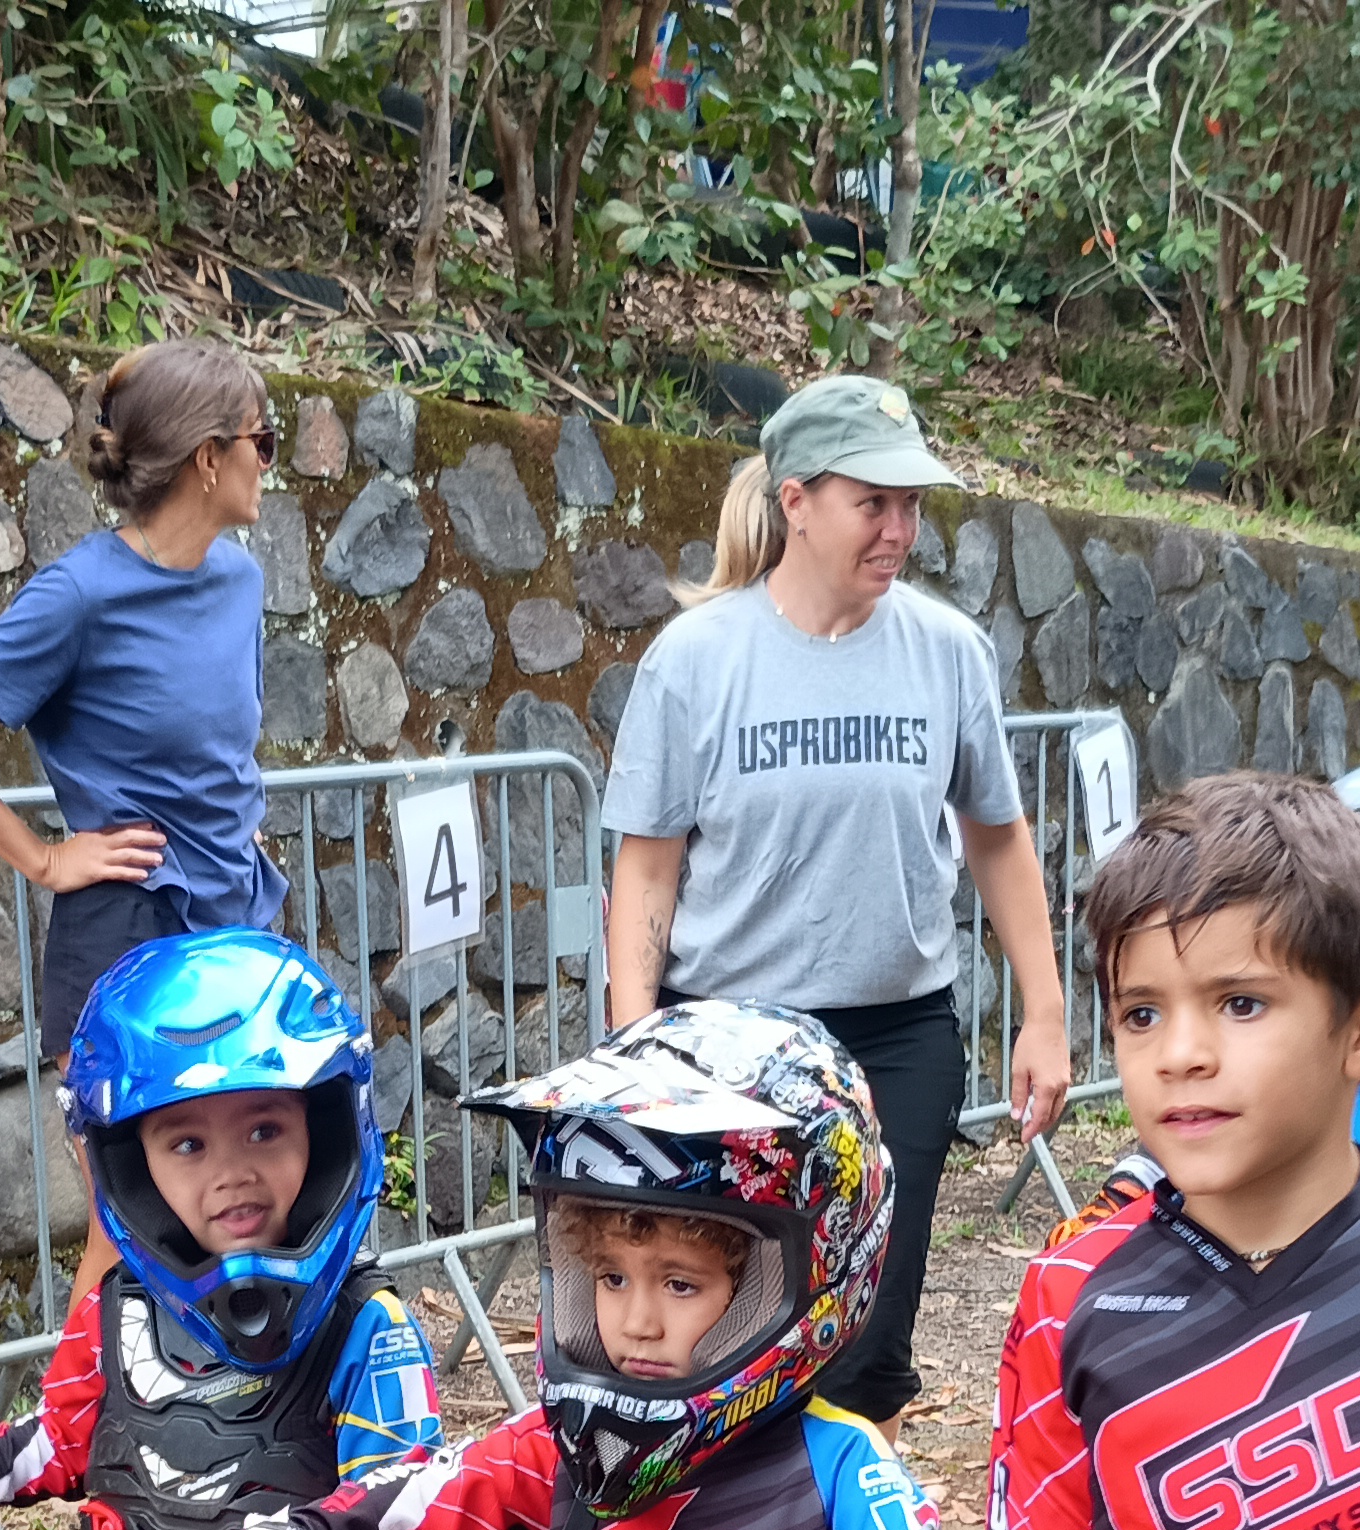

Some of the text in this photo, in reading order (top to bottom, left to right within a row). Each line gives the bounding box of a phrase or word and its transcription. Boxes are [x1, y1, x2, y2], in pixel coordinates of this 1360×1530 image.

[738, 715, 928, 775] USPROBIKES
[1096, 757, 1122, 837] 1
[424, 823, 467, 918] 4
